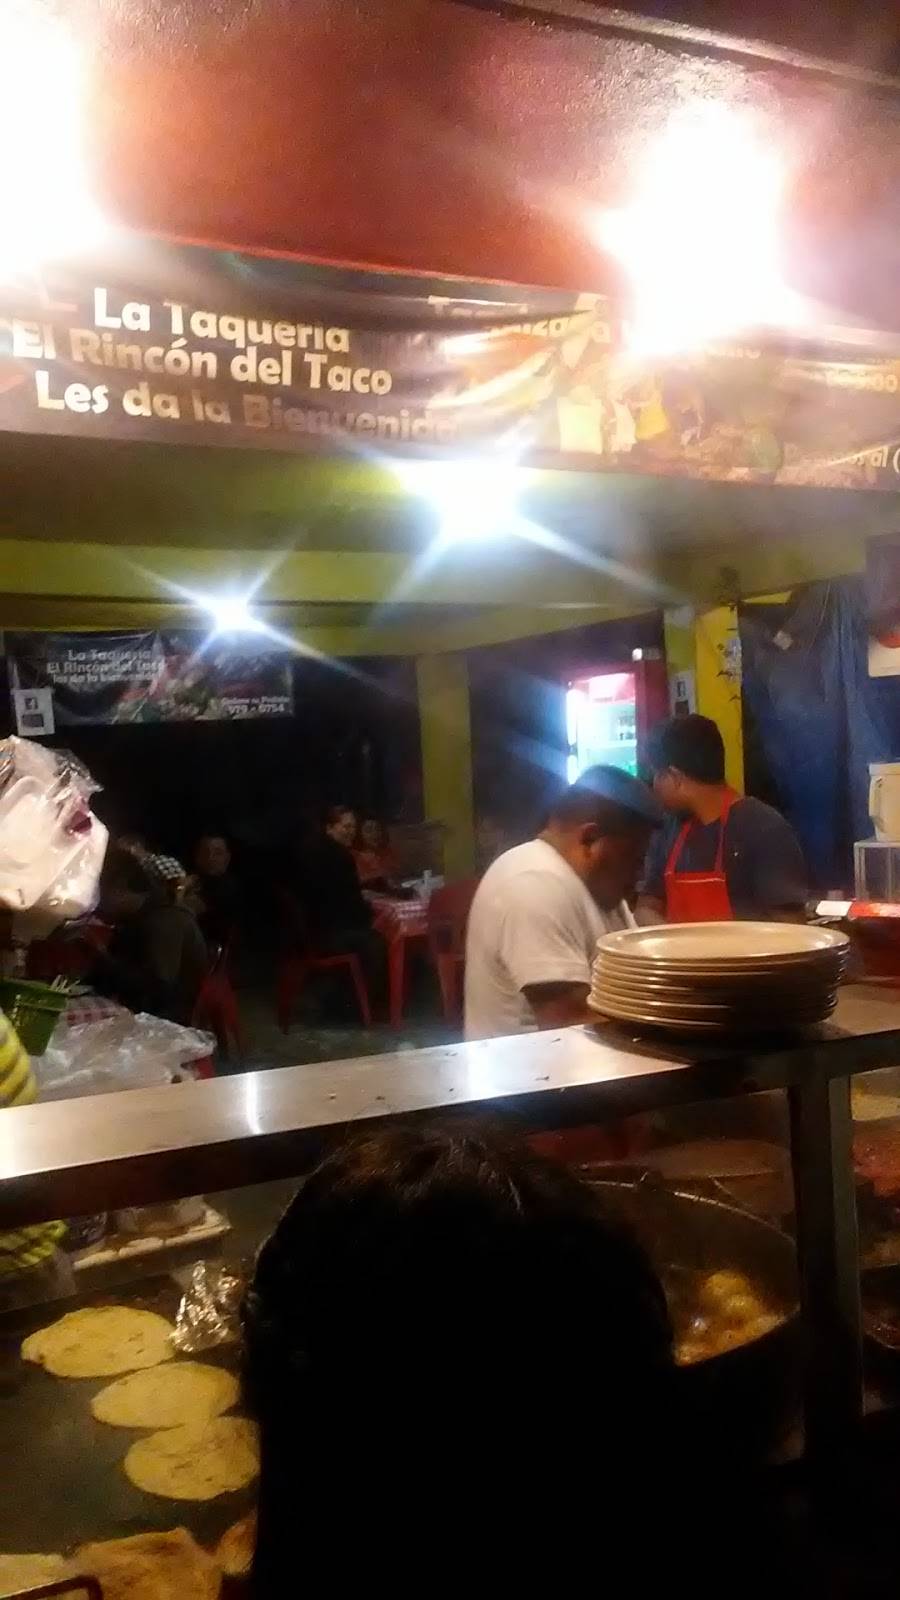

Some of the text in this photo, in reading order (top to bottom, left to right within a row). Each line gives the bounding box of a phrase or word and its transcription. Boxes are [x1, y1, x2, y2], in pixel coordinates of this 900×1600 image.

[94, 287, 150, 332] La
[12, 317, 392, 395] El Rincón del Taco
[35, 370, 109, 414] Les
[122, 382, 180, 419] da
[191, 390, 231, 424] la
[46, 662, 61, 674] El
